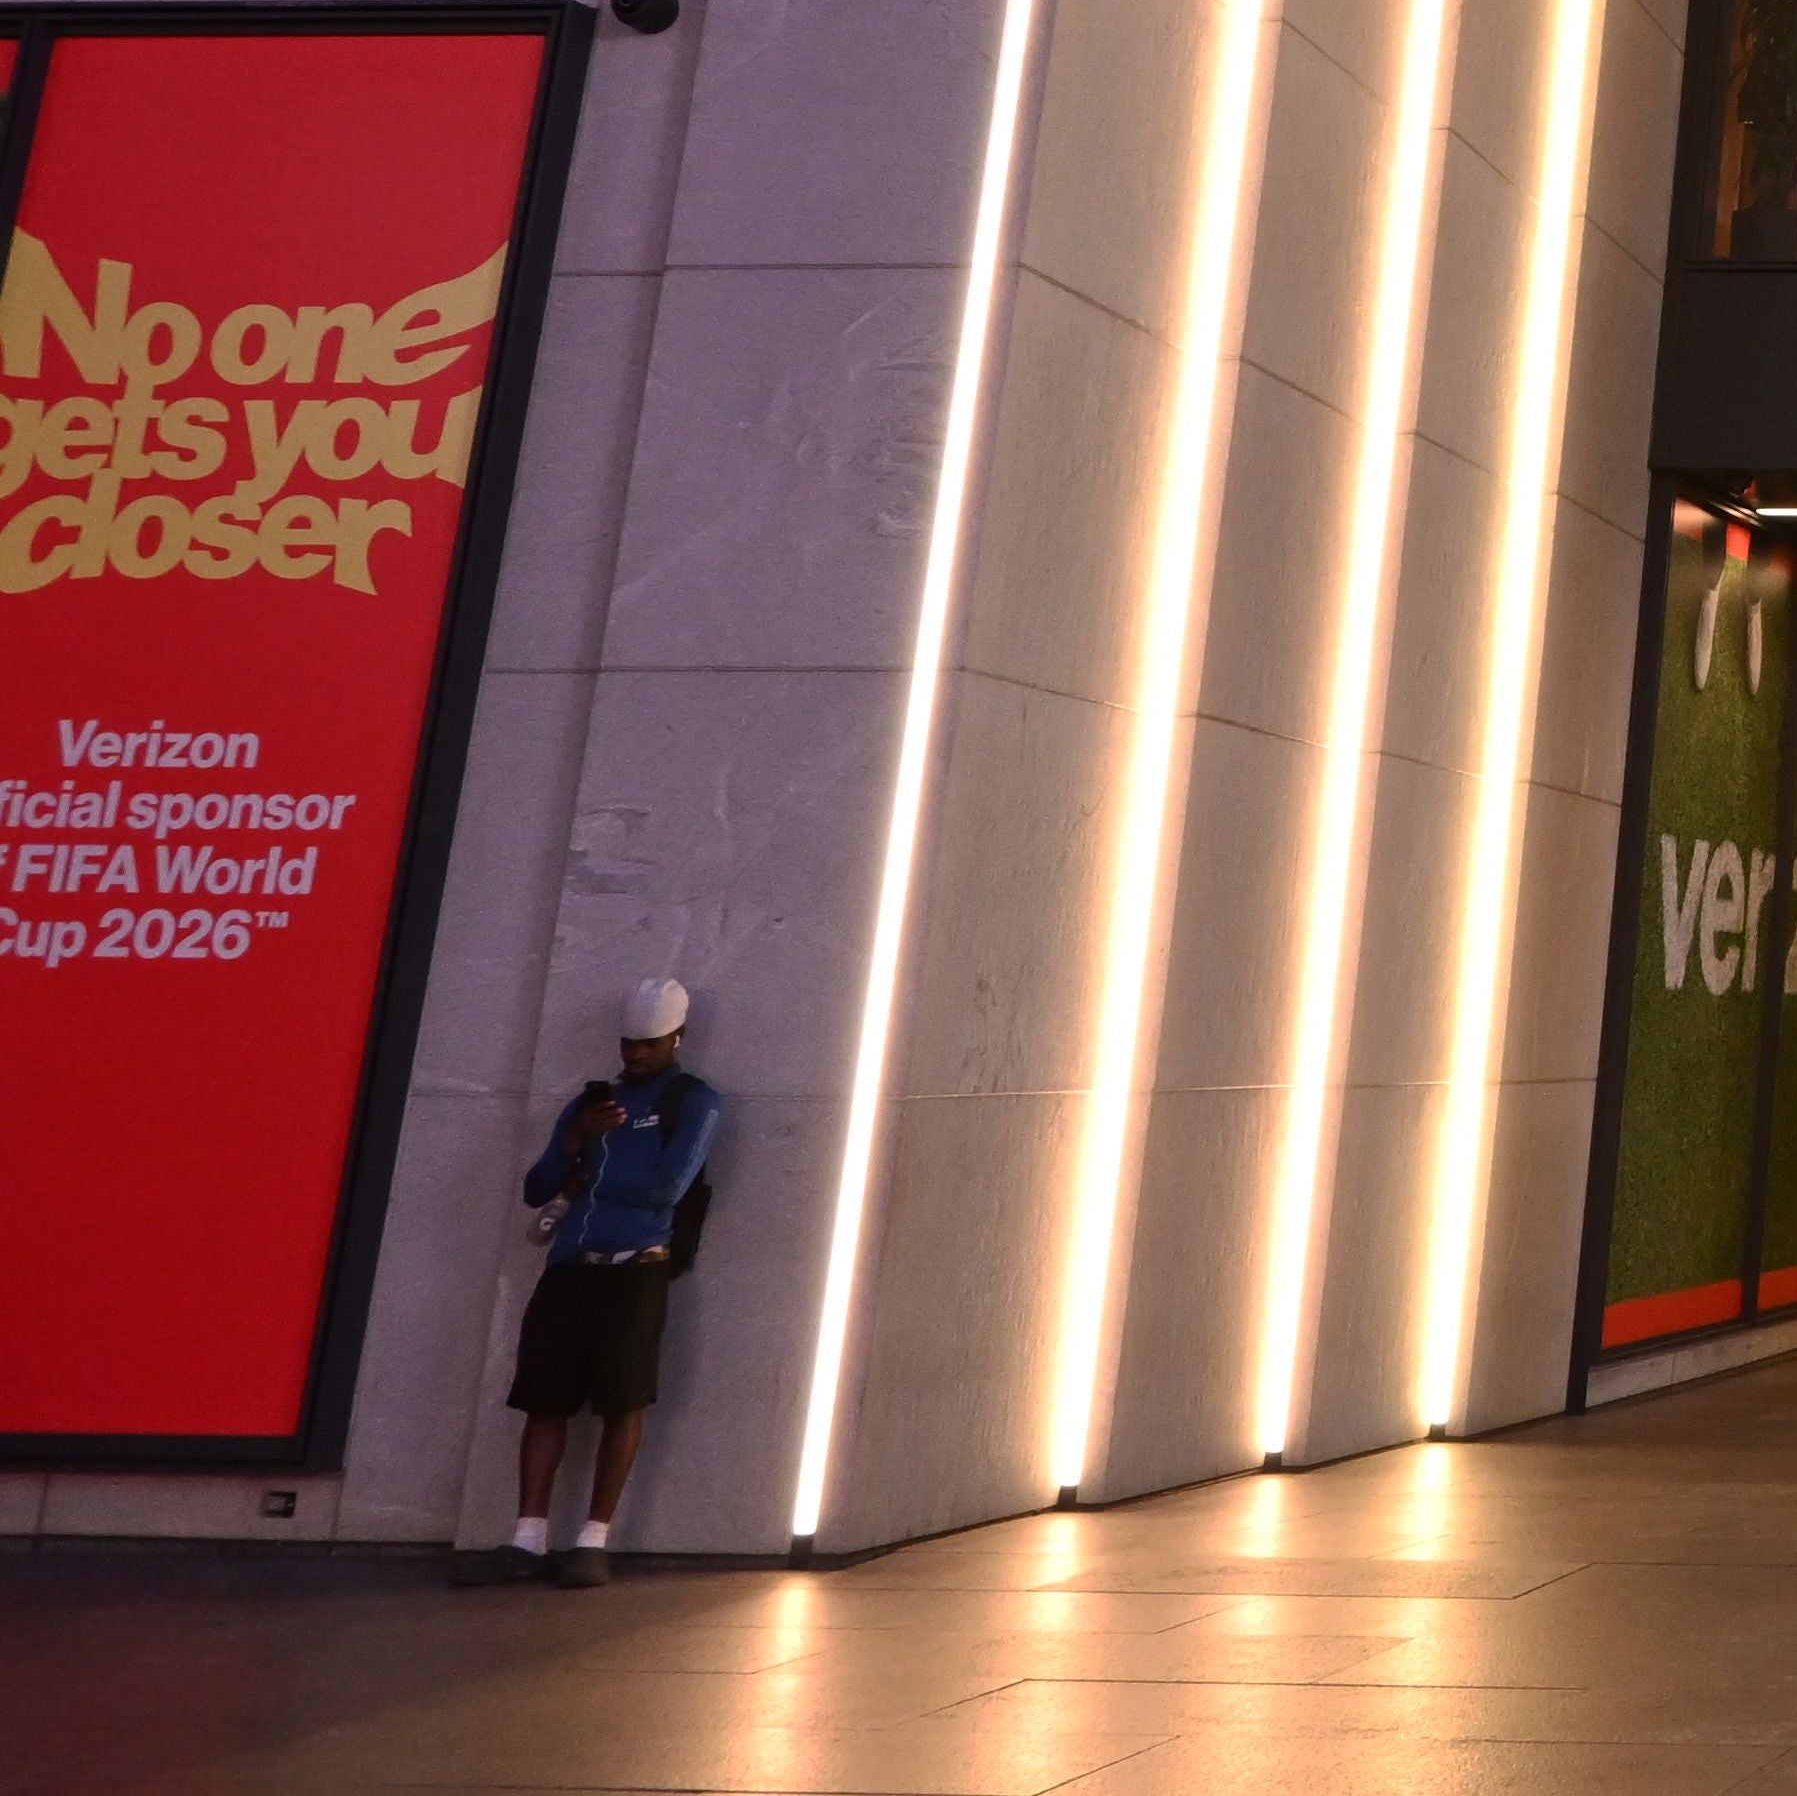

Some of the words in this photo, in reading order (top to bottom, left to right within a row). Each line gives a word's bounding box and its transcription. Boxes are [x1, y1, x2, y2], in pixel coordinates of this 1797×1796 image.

[0, 228, 200, 386] No
[209, 240, 508, 386] one
[233, 385, 483, 504] you
[0, 467, 412, 594] closer
[57, 718, 261, 769] Verizon
[0, 779, 123, 829] ficial
[126, 790, 357, 840] sponsor
[10, 843, 140, 894] FIFA
[154, 844, 319, 896] World
